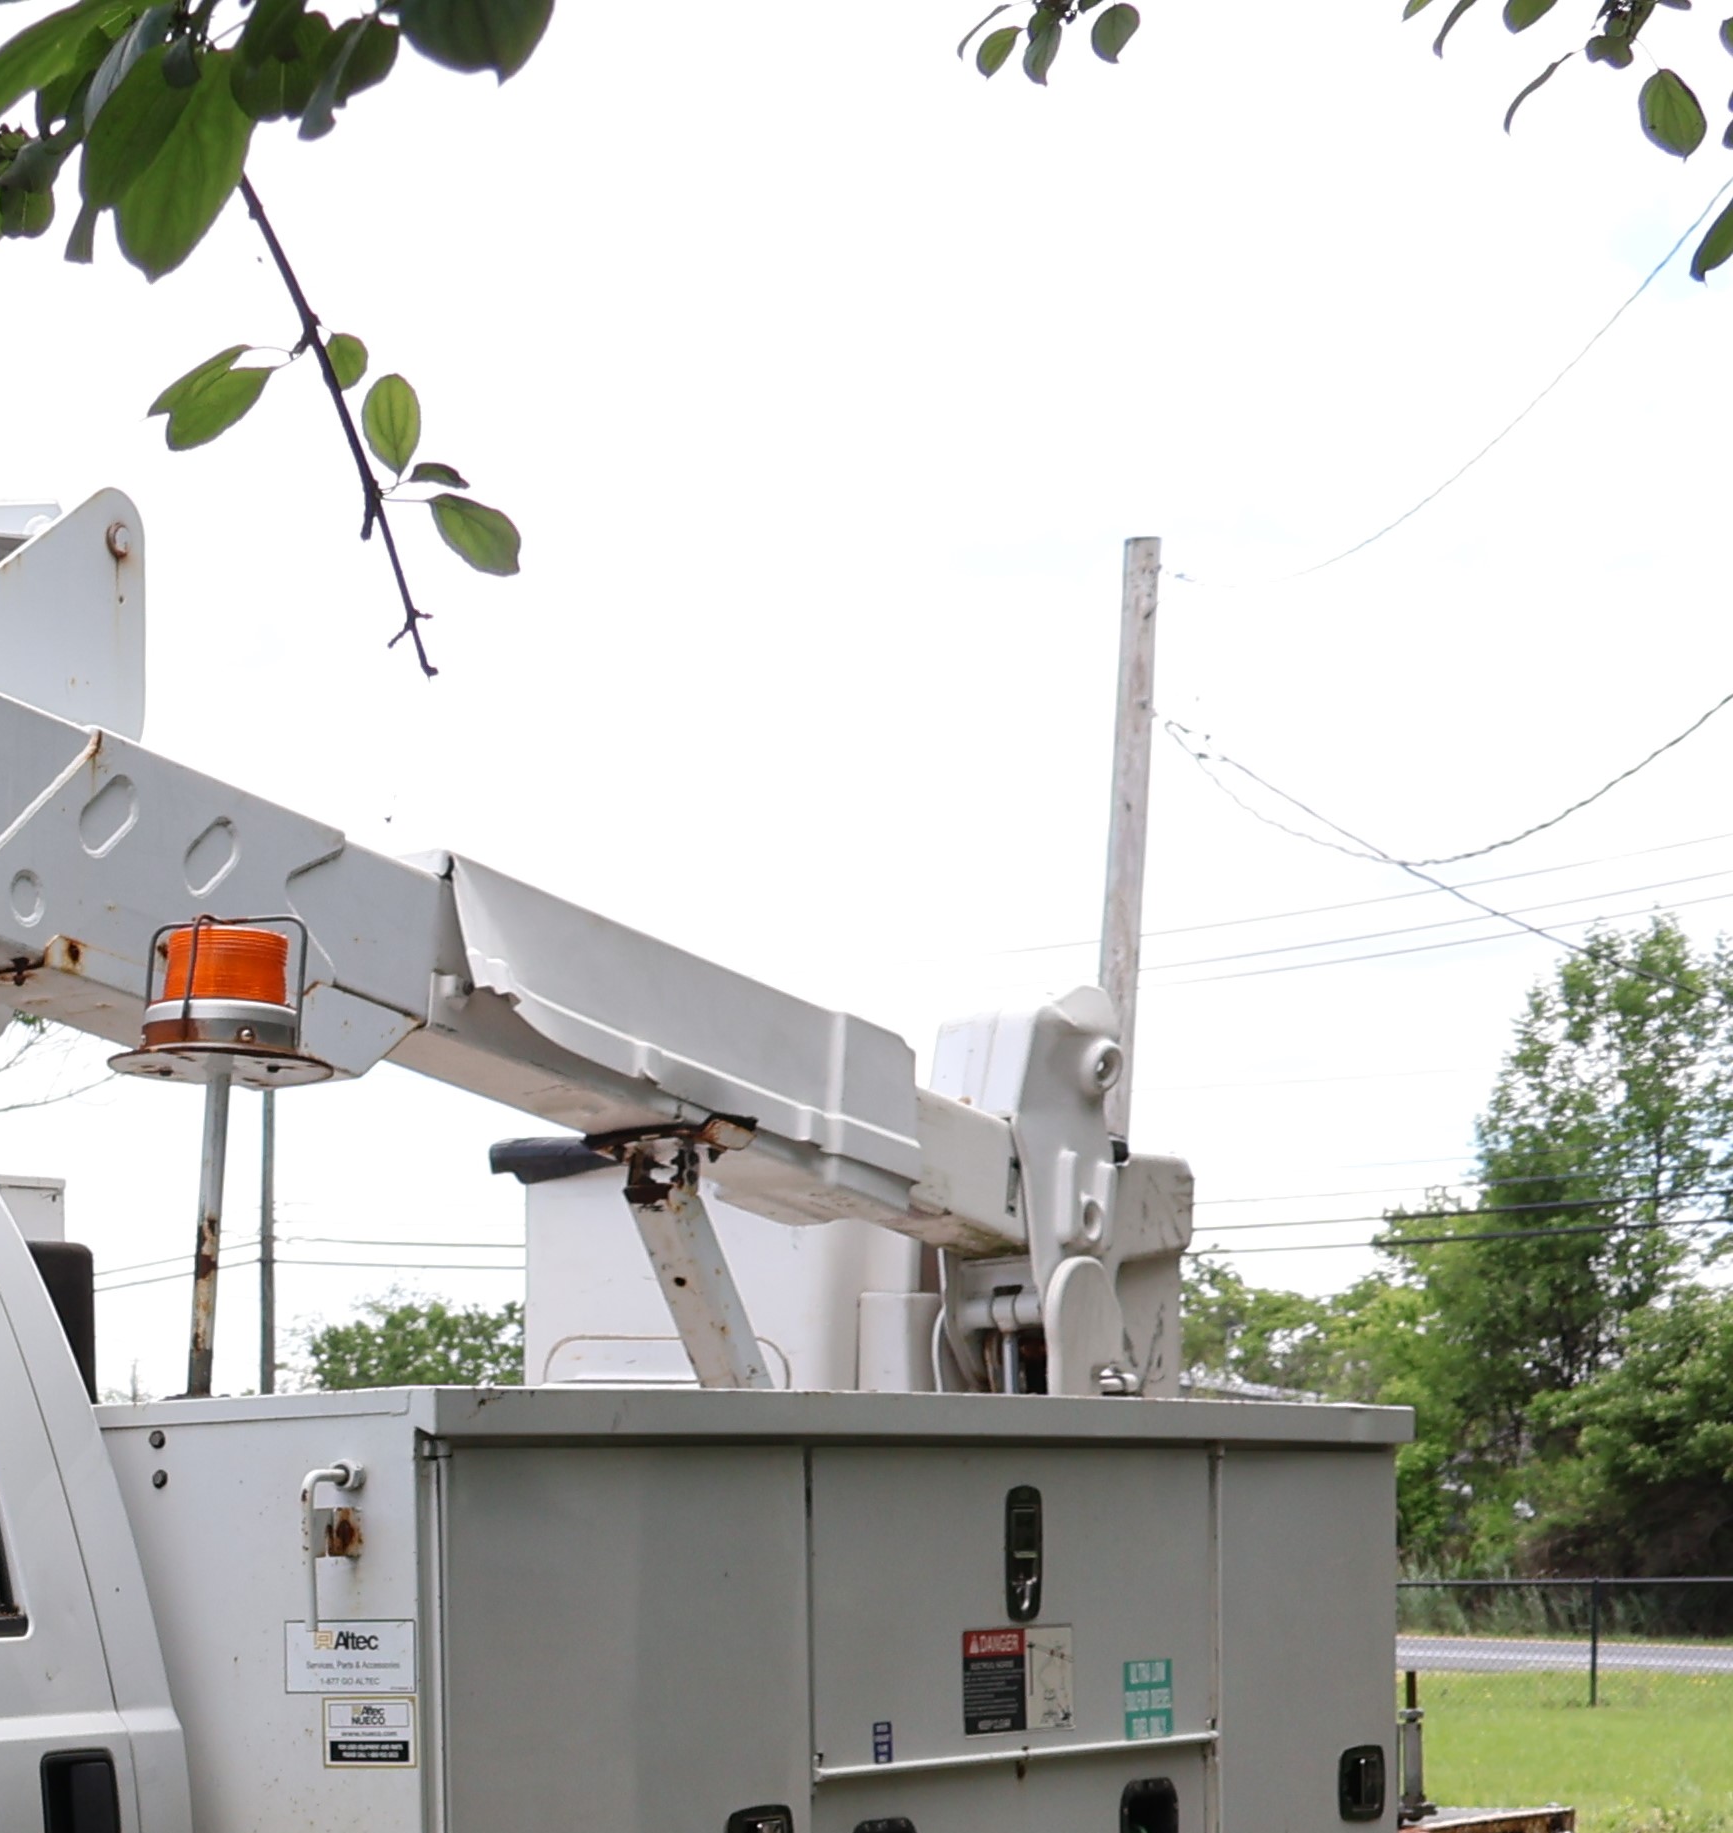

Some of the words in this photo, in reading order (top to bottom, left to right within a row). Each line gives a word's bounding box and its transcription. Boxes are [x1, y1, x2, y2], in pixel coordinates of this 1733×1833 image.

[334, 1630, 379, 1650] Altec
[978, 1633, 1021, 1653] DANGER
[355, 1676, 381, 1685] ALTEC
[360, 1705, 385, 1717] Altec
[351, 1716, 386, 1725] NUECO
